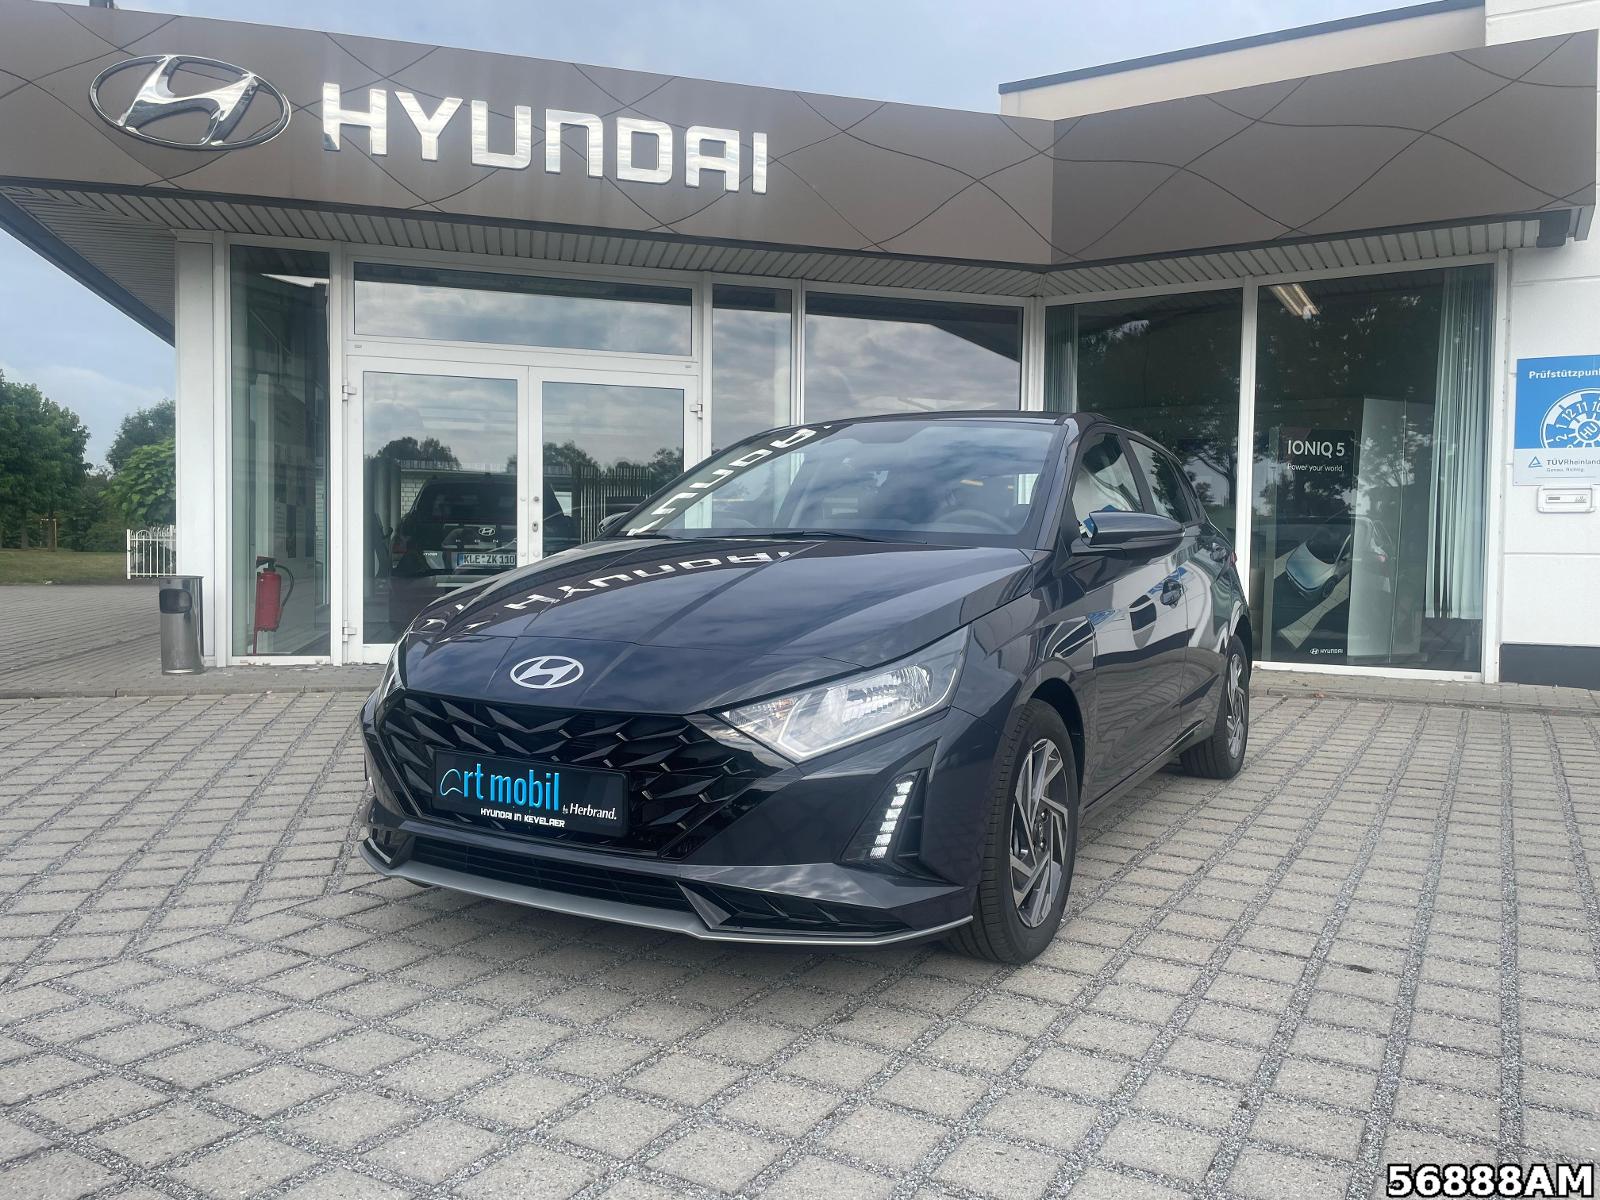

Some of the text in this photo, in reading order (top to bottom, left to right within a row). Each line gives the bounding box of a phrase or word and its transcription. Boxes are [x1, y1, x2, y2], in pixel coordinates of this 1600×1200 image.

[323, 82, 768, 195] HYUNDAI
[1528, 368, 1600, 379] Prüfstützpun
[1287, 439, 1345, 459] IONIQ 5
[1287, 462, 1345, 472] Power your world.
[490, 769, 560, 812] mobil
[480, 807, 513, 820] HYUNDAI
[524, 814, 566, 828] KEVELAER
[569, 802, 617, 820] Herbrand.
